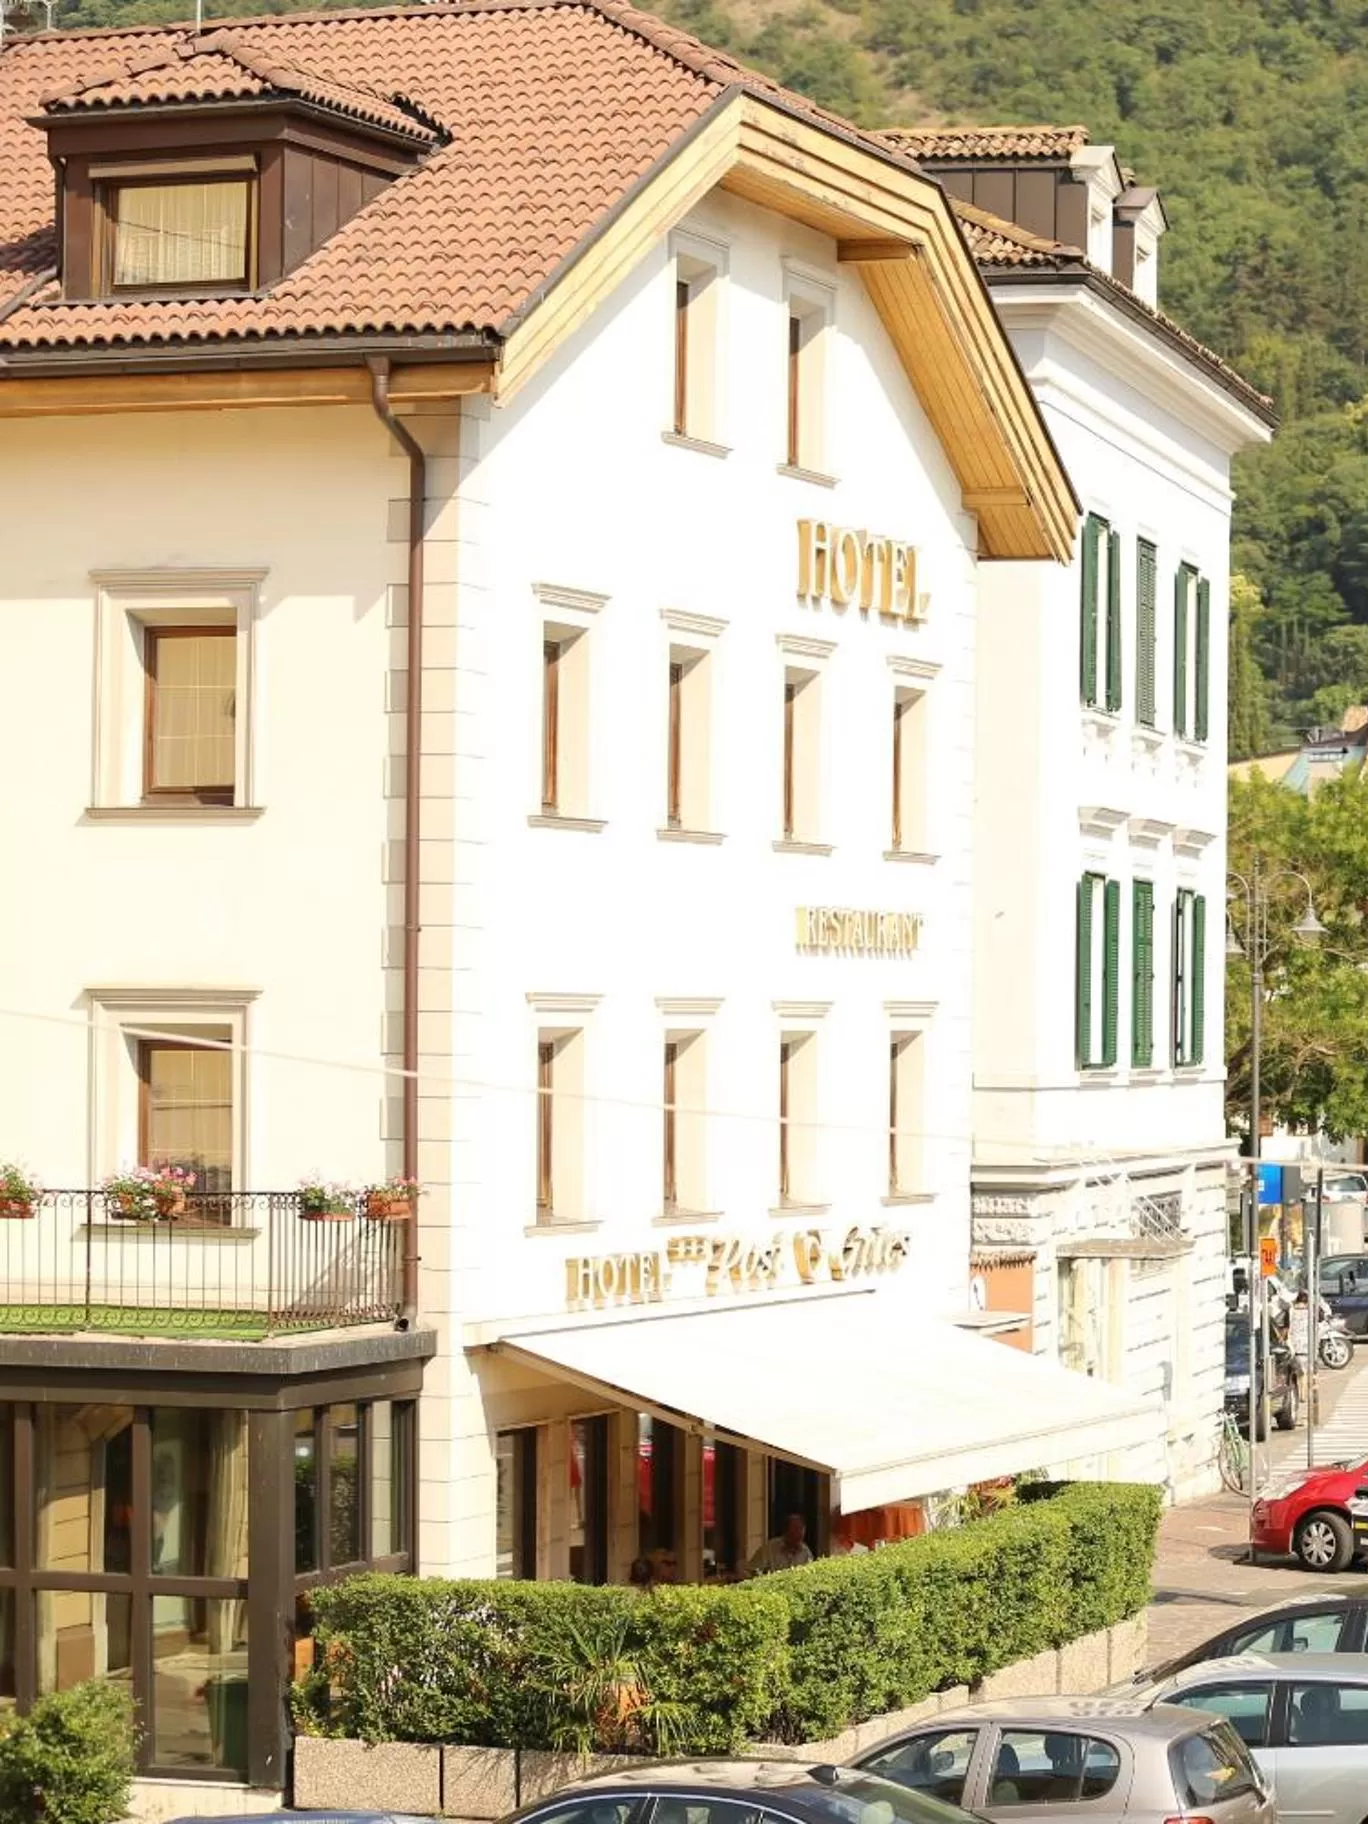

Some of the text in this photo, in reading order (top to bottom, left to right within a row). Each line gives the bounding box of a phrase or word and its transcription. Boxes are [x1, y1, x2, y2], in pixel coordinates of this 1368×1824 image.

[797, 518, 931, 625] HOTEL
[796, 906, 926, 956] RESTAURANT
[566, 1254, 672, 1309] HOTEL
